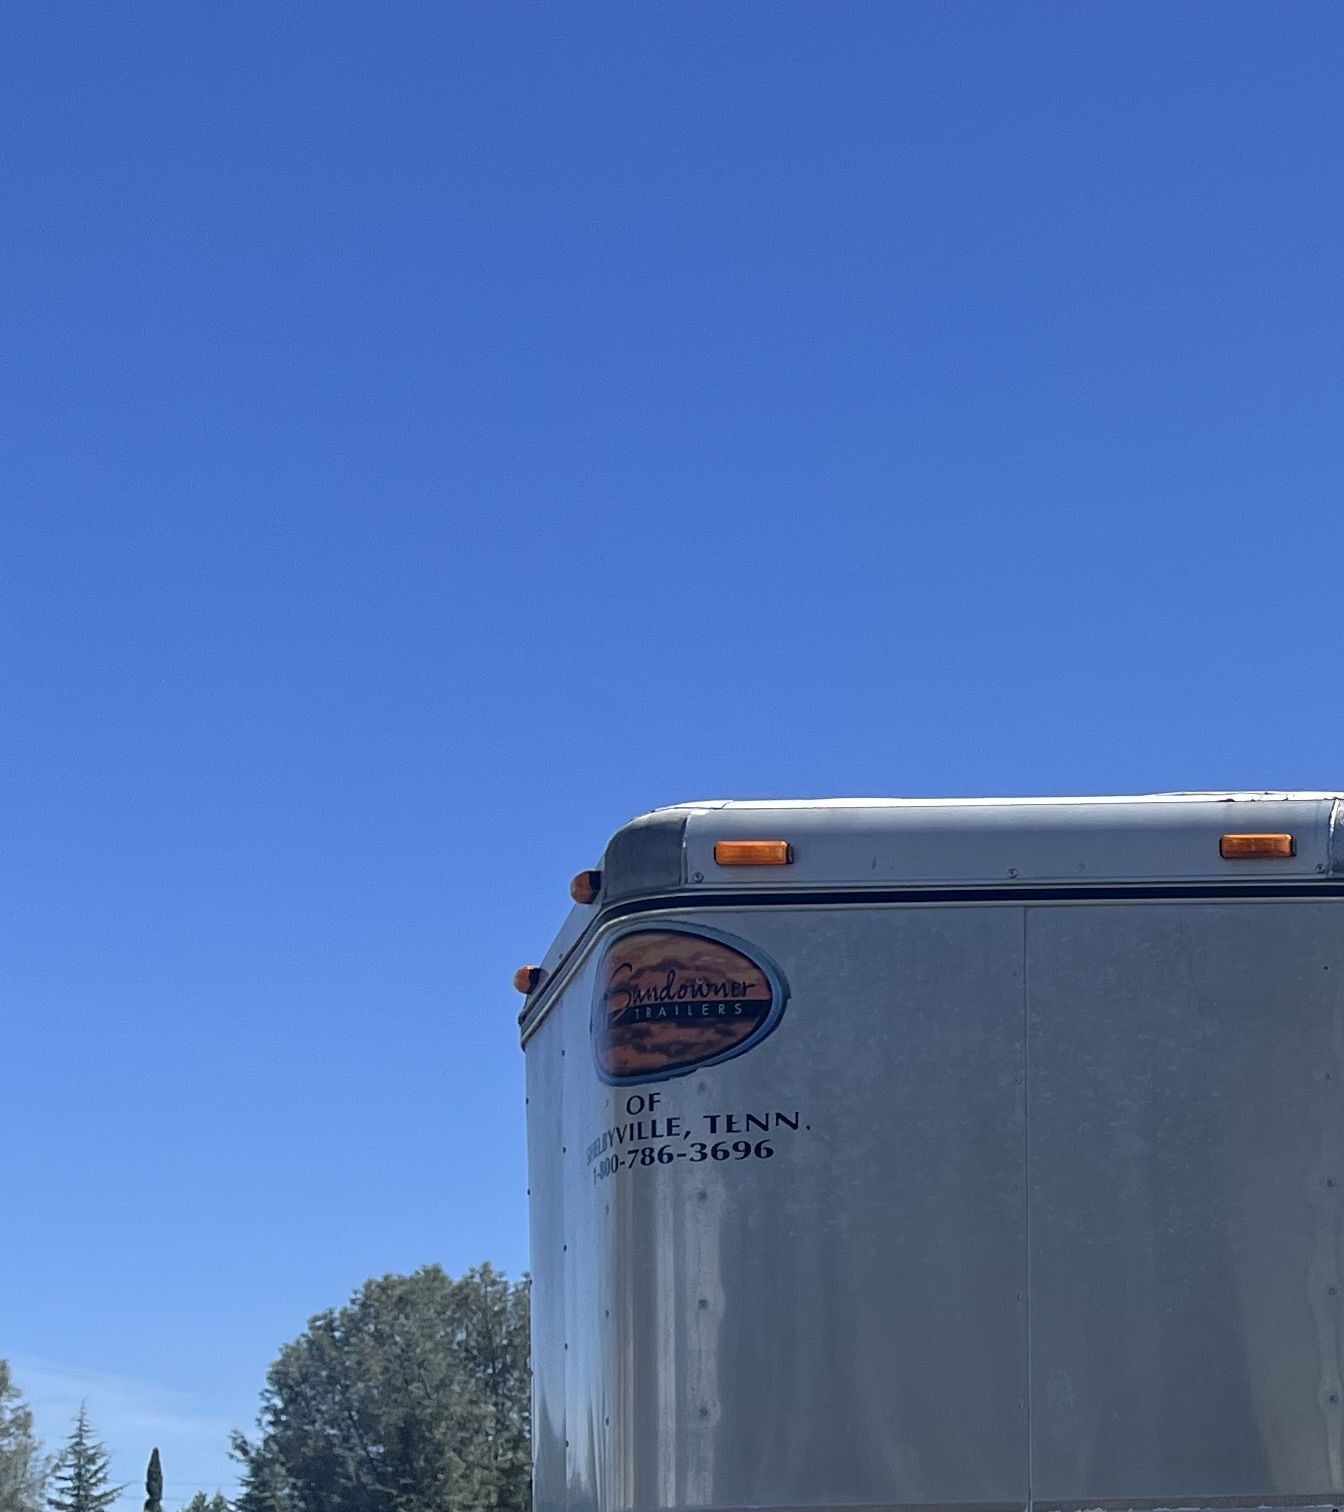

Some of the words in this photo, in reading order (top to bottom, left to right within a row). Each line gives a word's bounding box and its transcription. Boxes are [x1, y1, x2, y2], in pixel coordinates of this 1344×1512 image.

[603, 962, 756, 1021] Sundowner
[634, 1002, 743, 1019] TRAILERS
[626, 1092, 661, 1116] OF
[703, 1111, 811, 1135] TENN.
[592, 1139, 775, 1186] 1-800-786-3696
